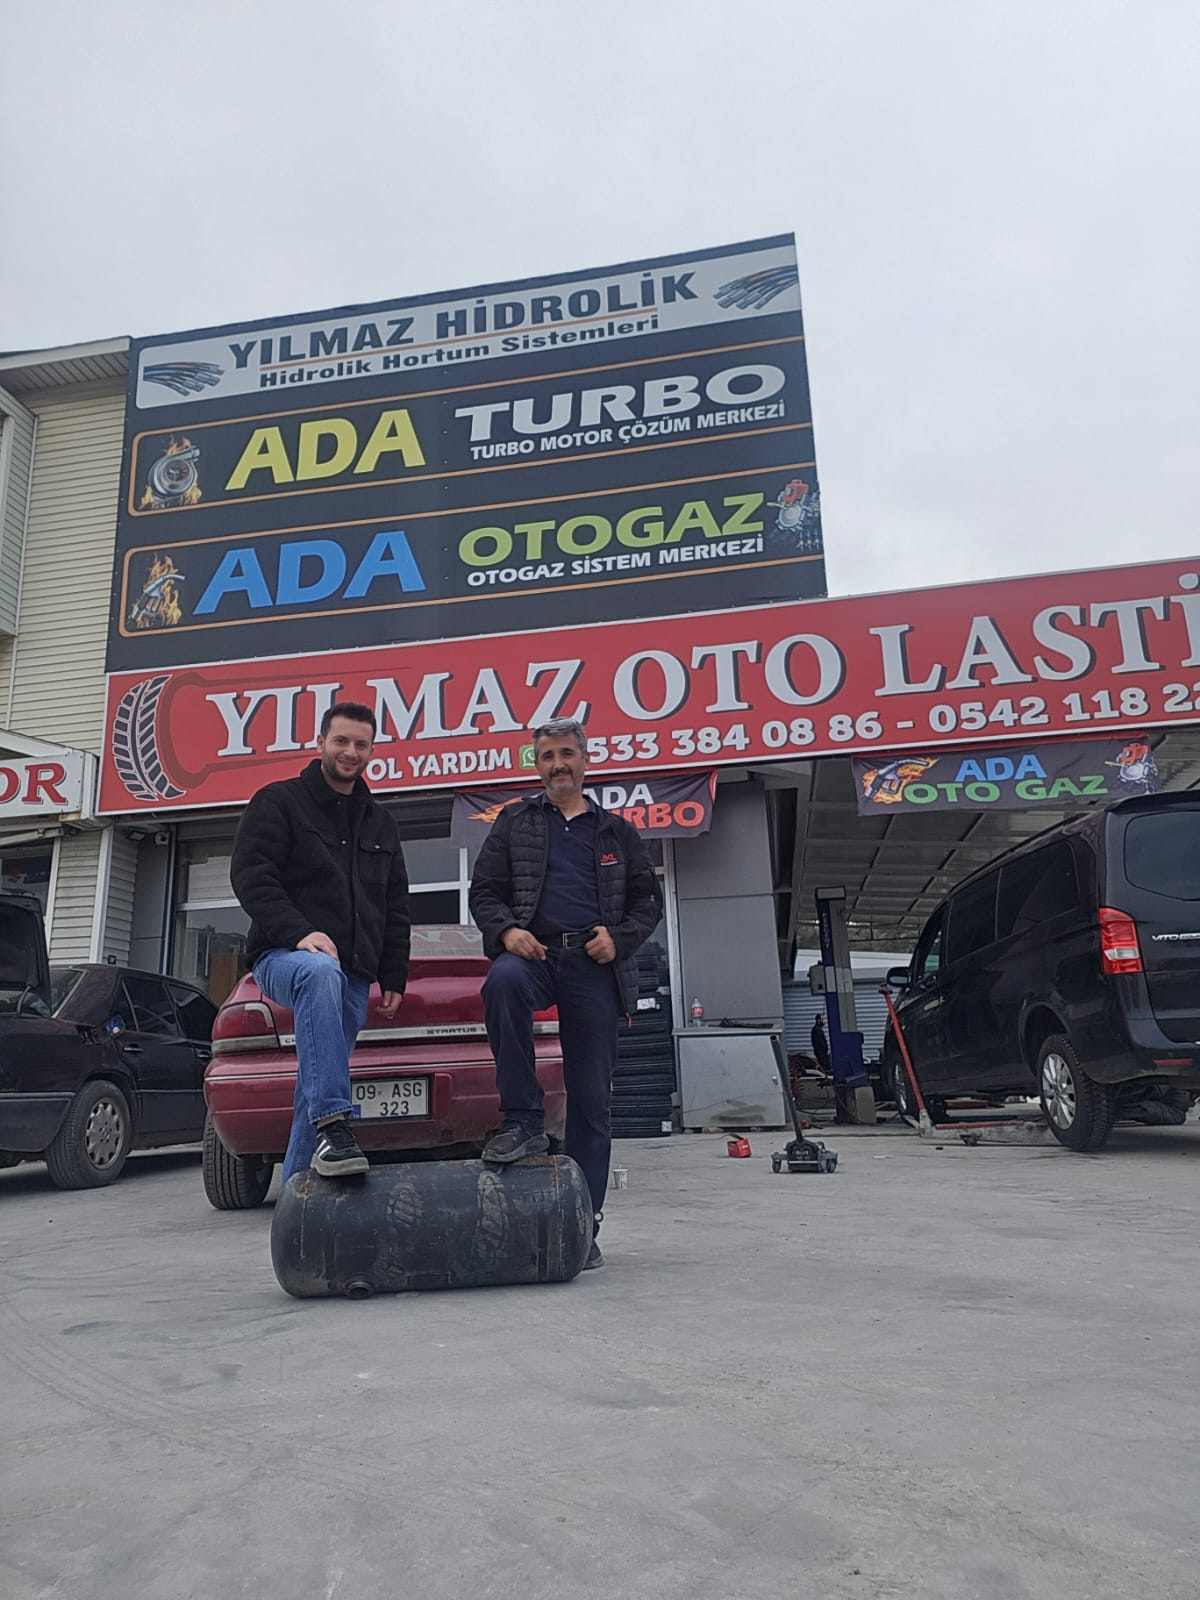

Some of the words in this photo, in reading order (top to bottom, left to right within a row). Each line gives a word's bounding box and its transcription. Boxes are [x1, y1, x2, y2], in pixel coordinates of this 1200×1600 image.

[228, 316, 414, 369] YILMAZ
[436, 272, 698, 340] HİDROLİK
[259, 359, 371, 388] Hidrolik
[382, 345, 490, 370] Hortum
[501, 314, 659, 352] Sistemleri
[225, 408, 426, 491] ADA
[454, 363, 786, 442] TURBO
[470, 439, 535, 460] TURBO
[540, 428, 613, 452] MOTOR
[618, 415, 691, 445] ÇÖZÜM
[696, 398, 785, 430] MERKEZİ
[193, 530, 427, 615] ADA
[458, 492, 765, 567] OTOGAZ
[467, 563, 565, 587] OTOGAZ
[571, 552, 651, 576] SİSTEM
[658, 533, 764, 565] MERKEZİ
[613, 633, 843, 721] OTO
[365, 756, 404, 782] OL
[408, 747, 512, 778] YARDIM
[586, 732, 660, 764] 533
[672, 724, 750, 756] 384
[761, 718, 815, 748] 08
[828, 711, 883, 742] 86
[929, 696, 1049, 733] 0542
[1062, 687, 1149, 723] 118
[955, 754, 1048, 783] ADA
[903, 780, 1000, 804] OTO
[1015, 775, 1108, 801] GAZ
[356, 1085, 376, 1101] 09
[391, 1082, 423, 1098] ASG
[379, 1100, 410, 1116] 323
